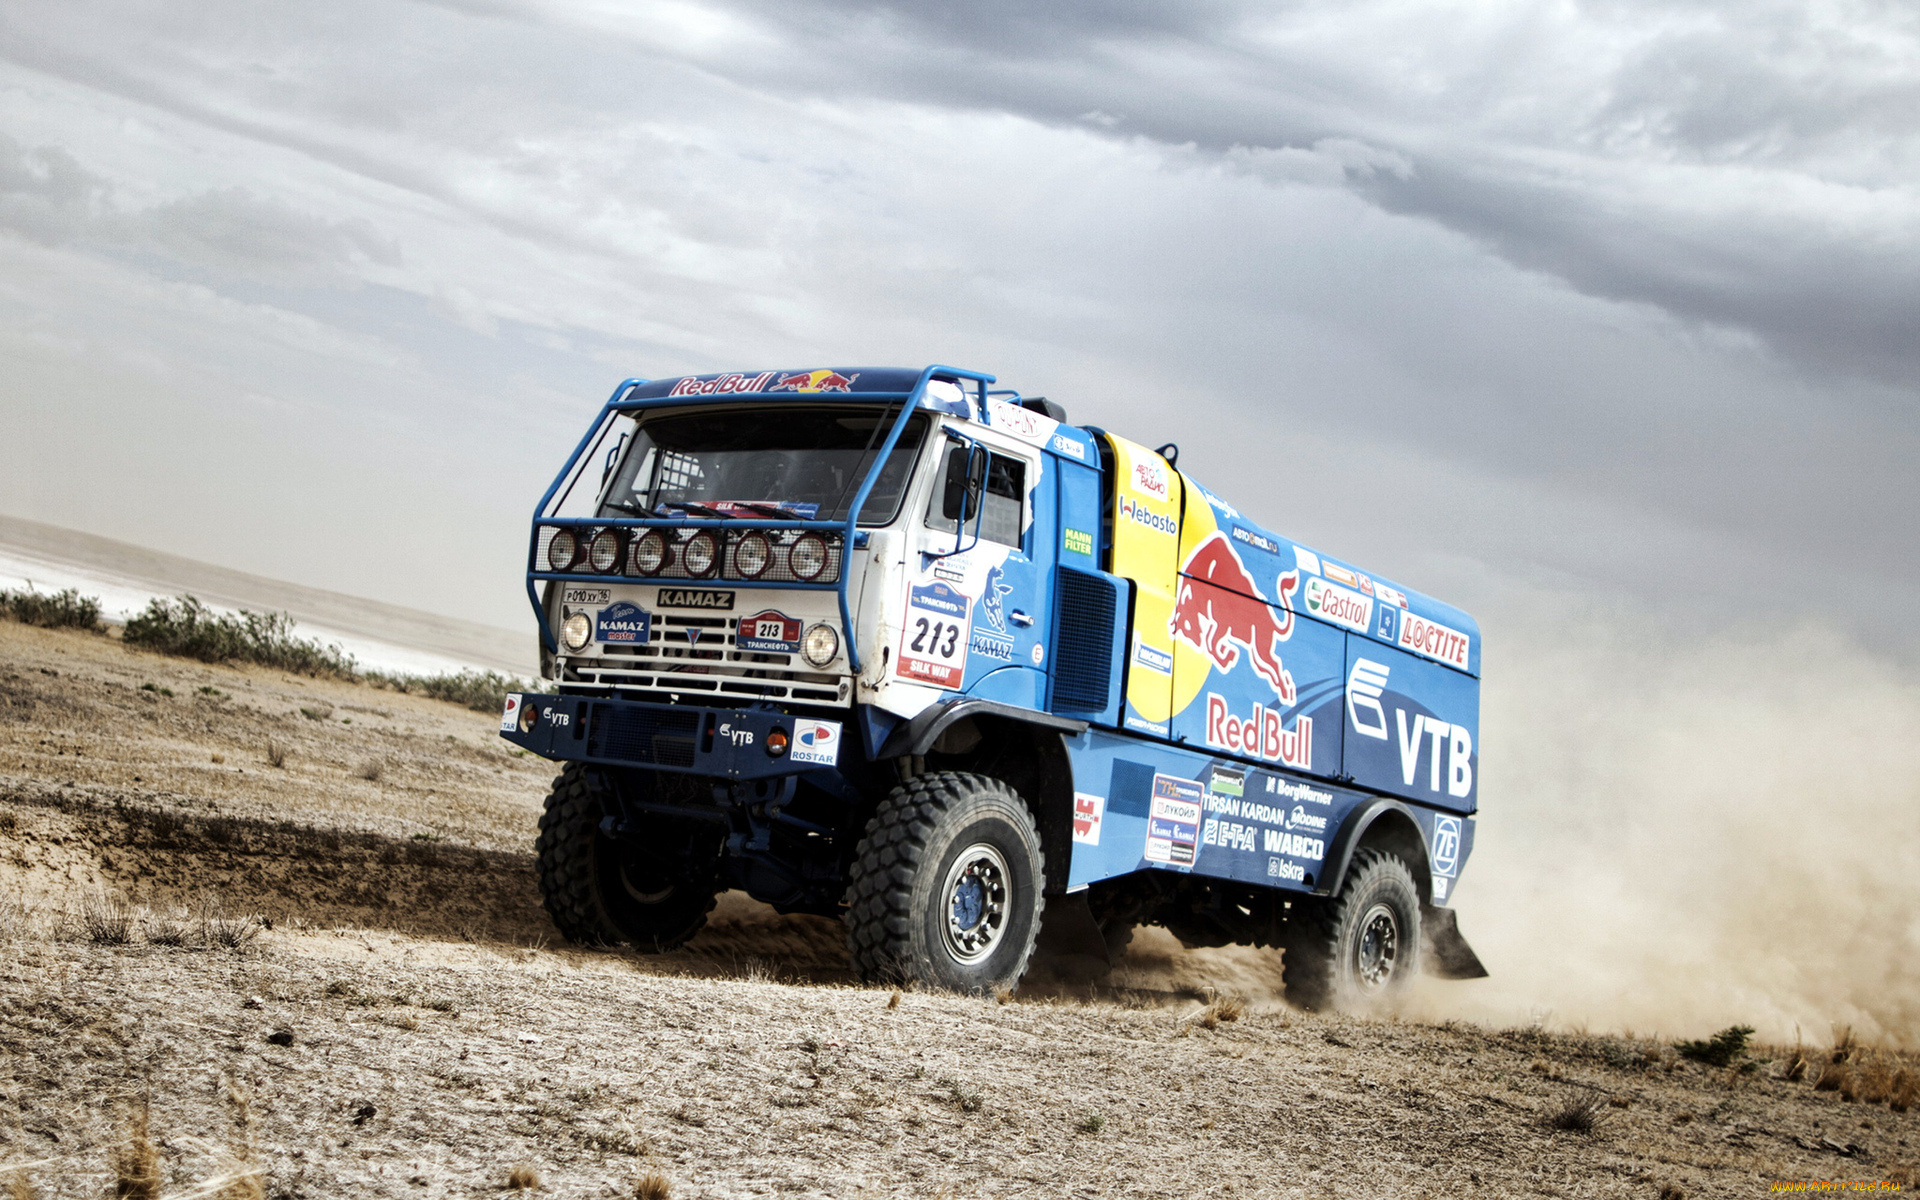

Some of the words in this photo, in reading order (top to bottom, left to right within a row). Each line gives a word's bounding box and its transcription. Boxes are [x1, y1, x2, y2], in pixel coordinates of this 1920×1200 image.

[669, 376, 728, 397] Red
[716, 371, 776, 394] Bull
[1119, 496, 1177, 534] Webasto
[1065, 528, 1092, 545] MANN
[1065, 539, 1092, 555] FILTER
[660, 590, 731, 607] KAMAZ
[1322, 588, 1368, 626] Castrol
[600, 620, 644, 631] KAMAZ
[760, 623, 780, 637] 213
[608, 631, 636, 641] master
[910, 617, 960, 659] 213
[1401, 616, 1467, 663] LOCTITE
[747, 641, 790, 651] ТРАНСНЕФТЬ
[971, 634, 1013, 662] KAMAZ
[910, 660, 931, 675] SILK
[931, 664, 951, 679] WAY
[551, 712, 570, 726] VTB
[731, 730, 754, 744] VTB
[1206, 691, 1263, 757] Red
[1262, 707, 1313, 769] Bull
[792, 750, 833, 763] ROSTAR
[1395, 707, 1473, 799] VTB
[1276, 778, 1333, 805] BorgWarner
[1164, 804, 1195, 819] ЛУКОЙЛ
[1240, 801, 1285, 825] KARDAN
[1290, 812, 1327, 829] MODINE
[1264, 828, 1324, 861] WABCO
[1278, 859, 1304, 880] Iskra
